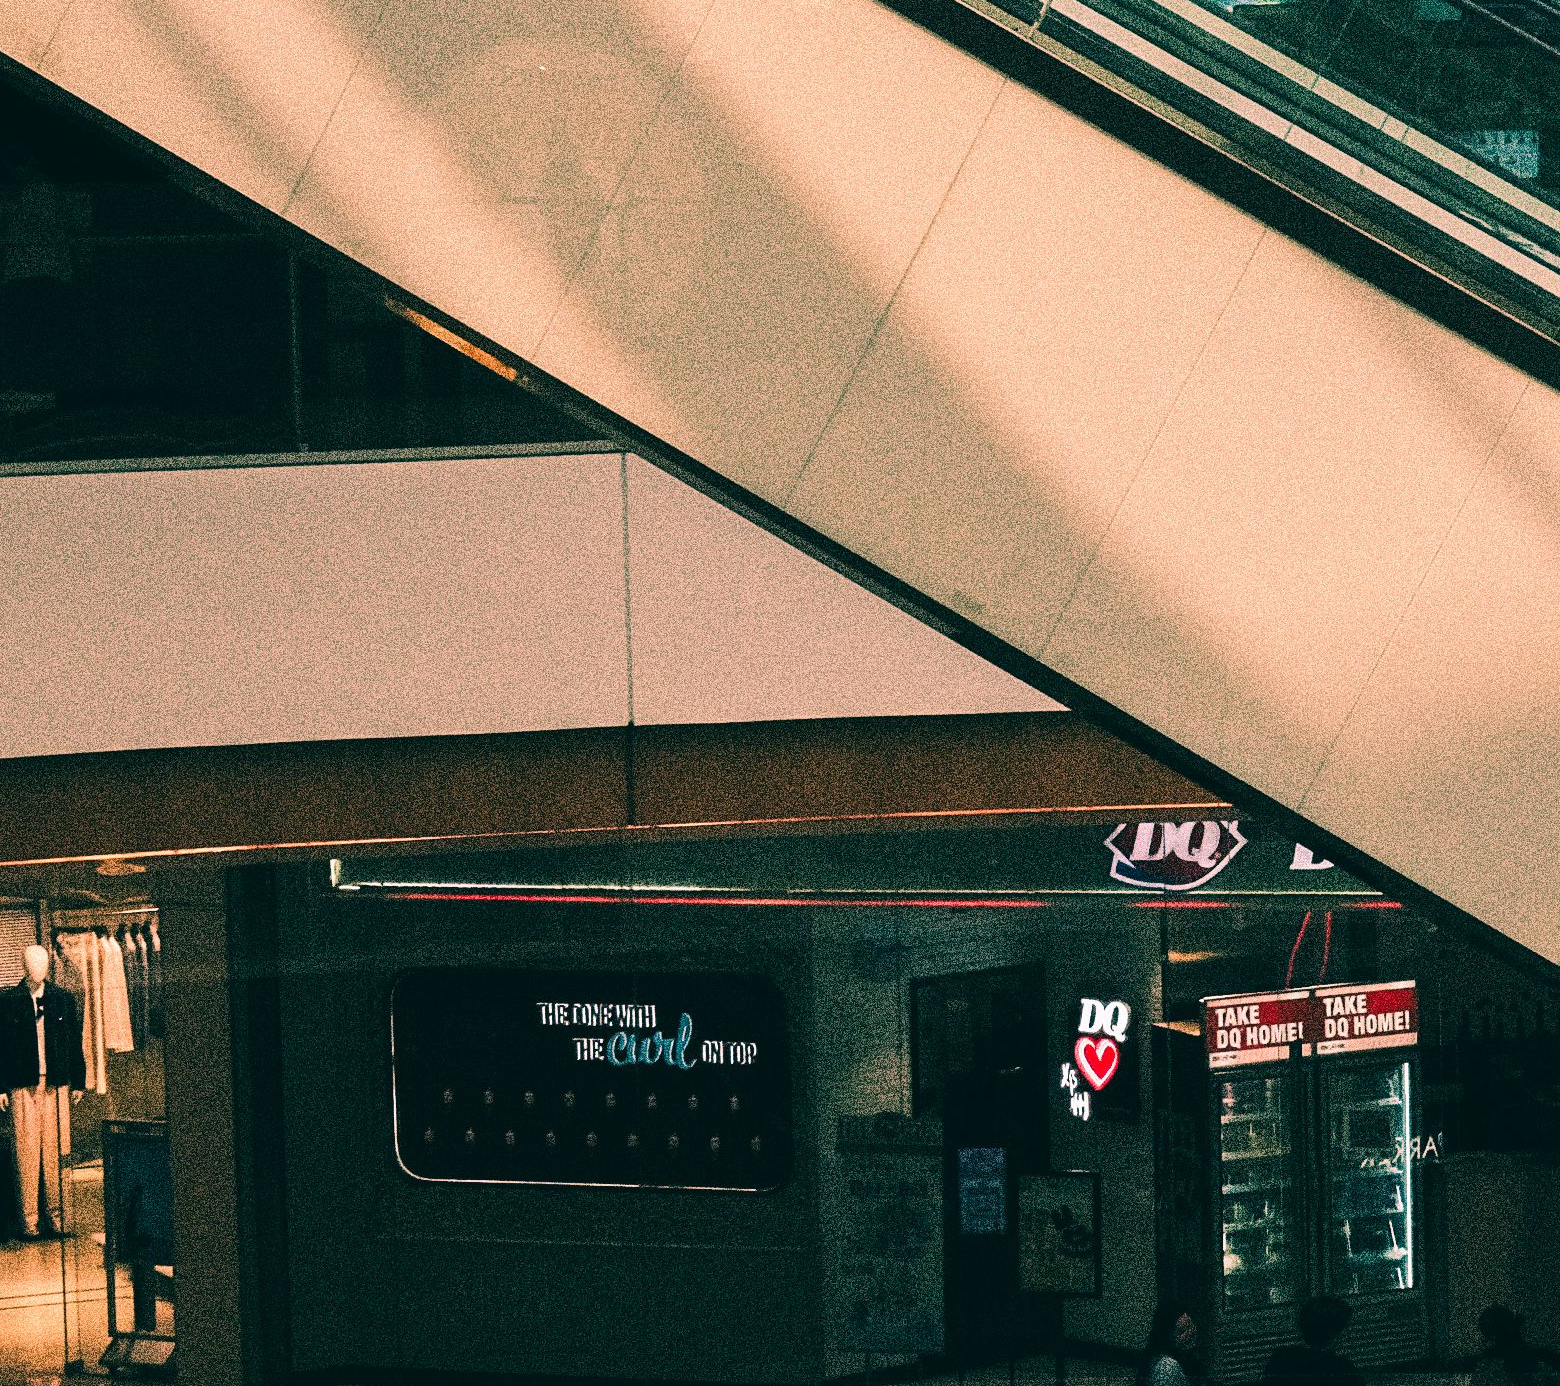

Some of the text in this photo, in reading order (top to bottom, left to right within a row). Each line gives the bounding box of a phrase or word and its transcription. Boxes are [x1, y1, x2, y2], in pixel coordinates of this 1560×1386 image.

[1214, 1005, 1260, 1027] TAKE
[1323, 995, 1367, 1017] TAKE
[1077, 997, 1132, 1043] DQ
[1325, 1011, 1410, 1038] DQ HOME!
[1216, 1022, 1304, 1049] DQ HOME!
